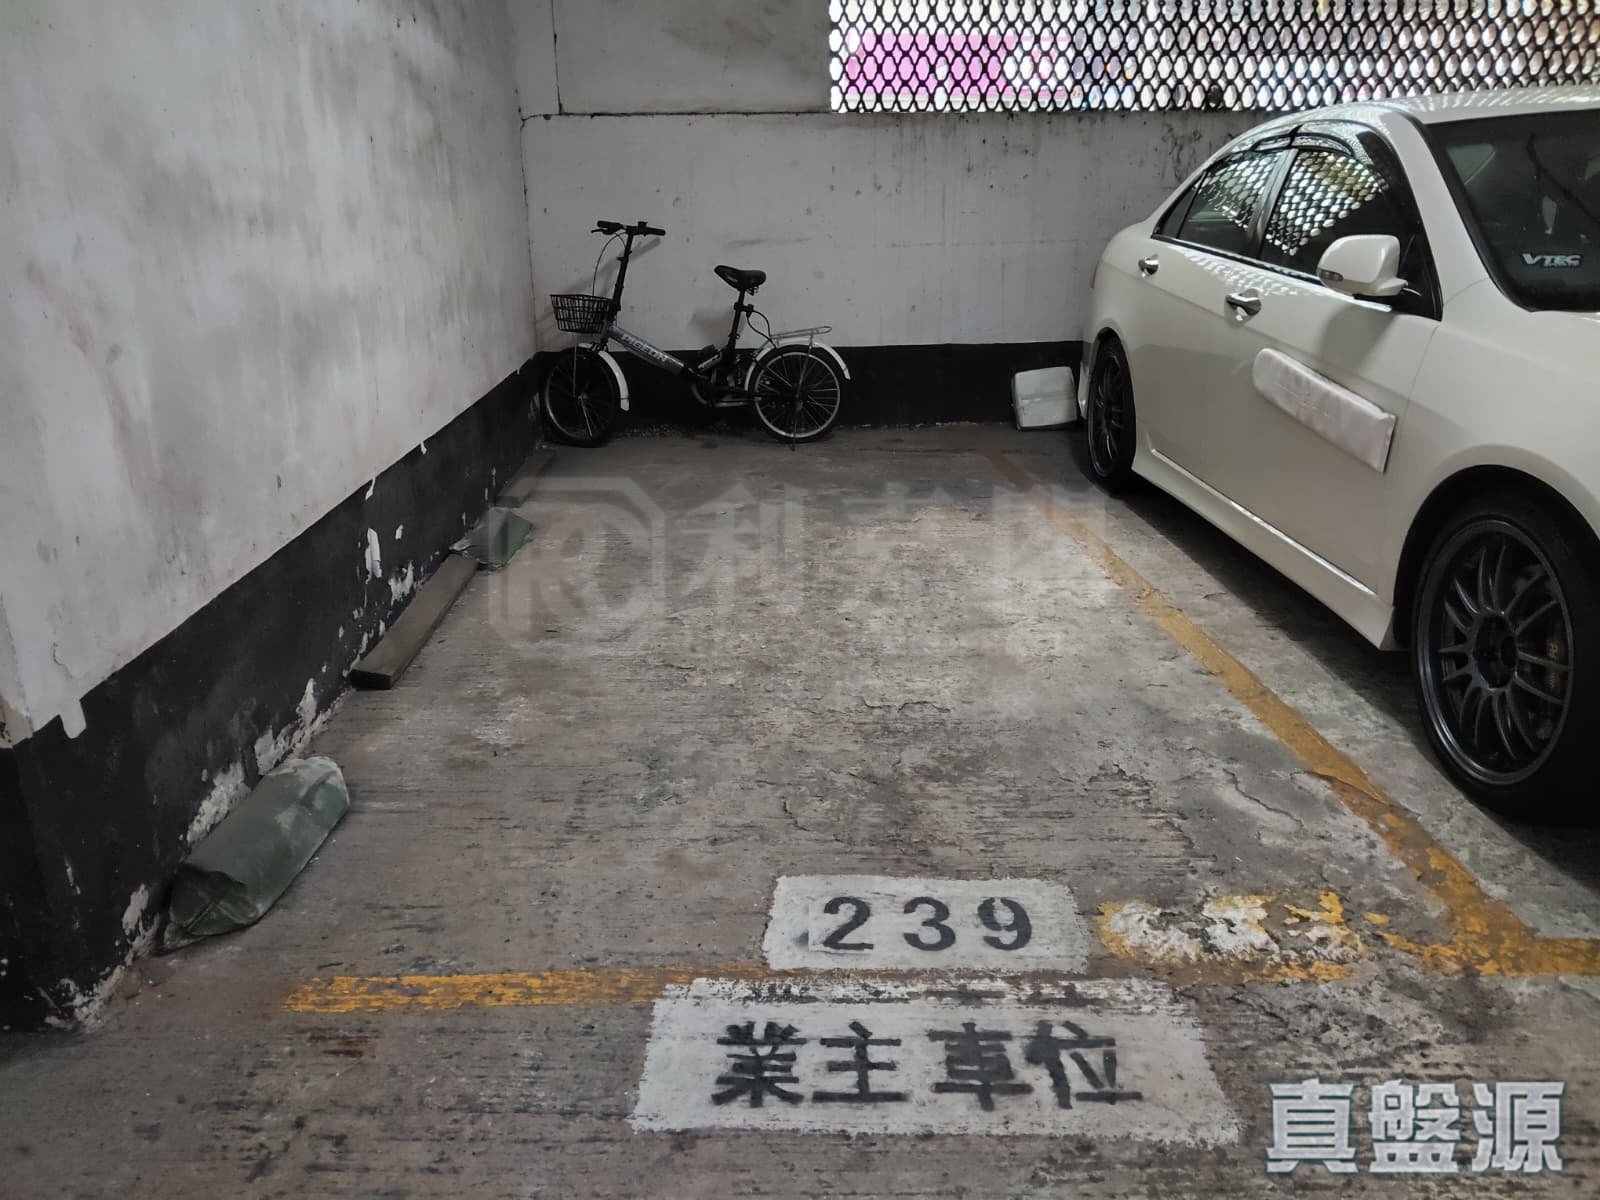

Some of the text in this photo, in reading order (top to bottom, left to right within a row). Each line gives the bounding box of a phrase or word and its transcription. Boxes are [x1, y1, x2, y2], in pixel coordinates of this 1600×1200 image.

[1522, 253, 1581, 267] VTEC
[821, 895, 1034, 952] 239
[710, 1019, 1144, 1110] 業主車位
